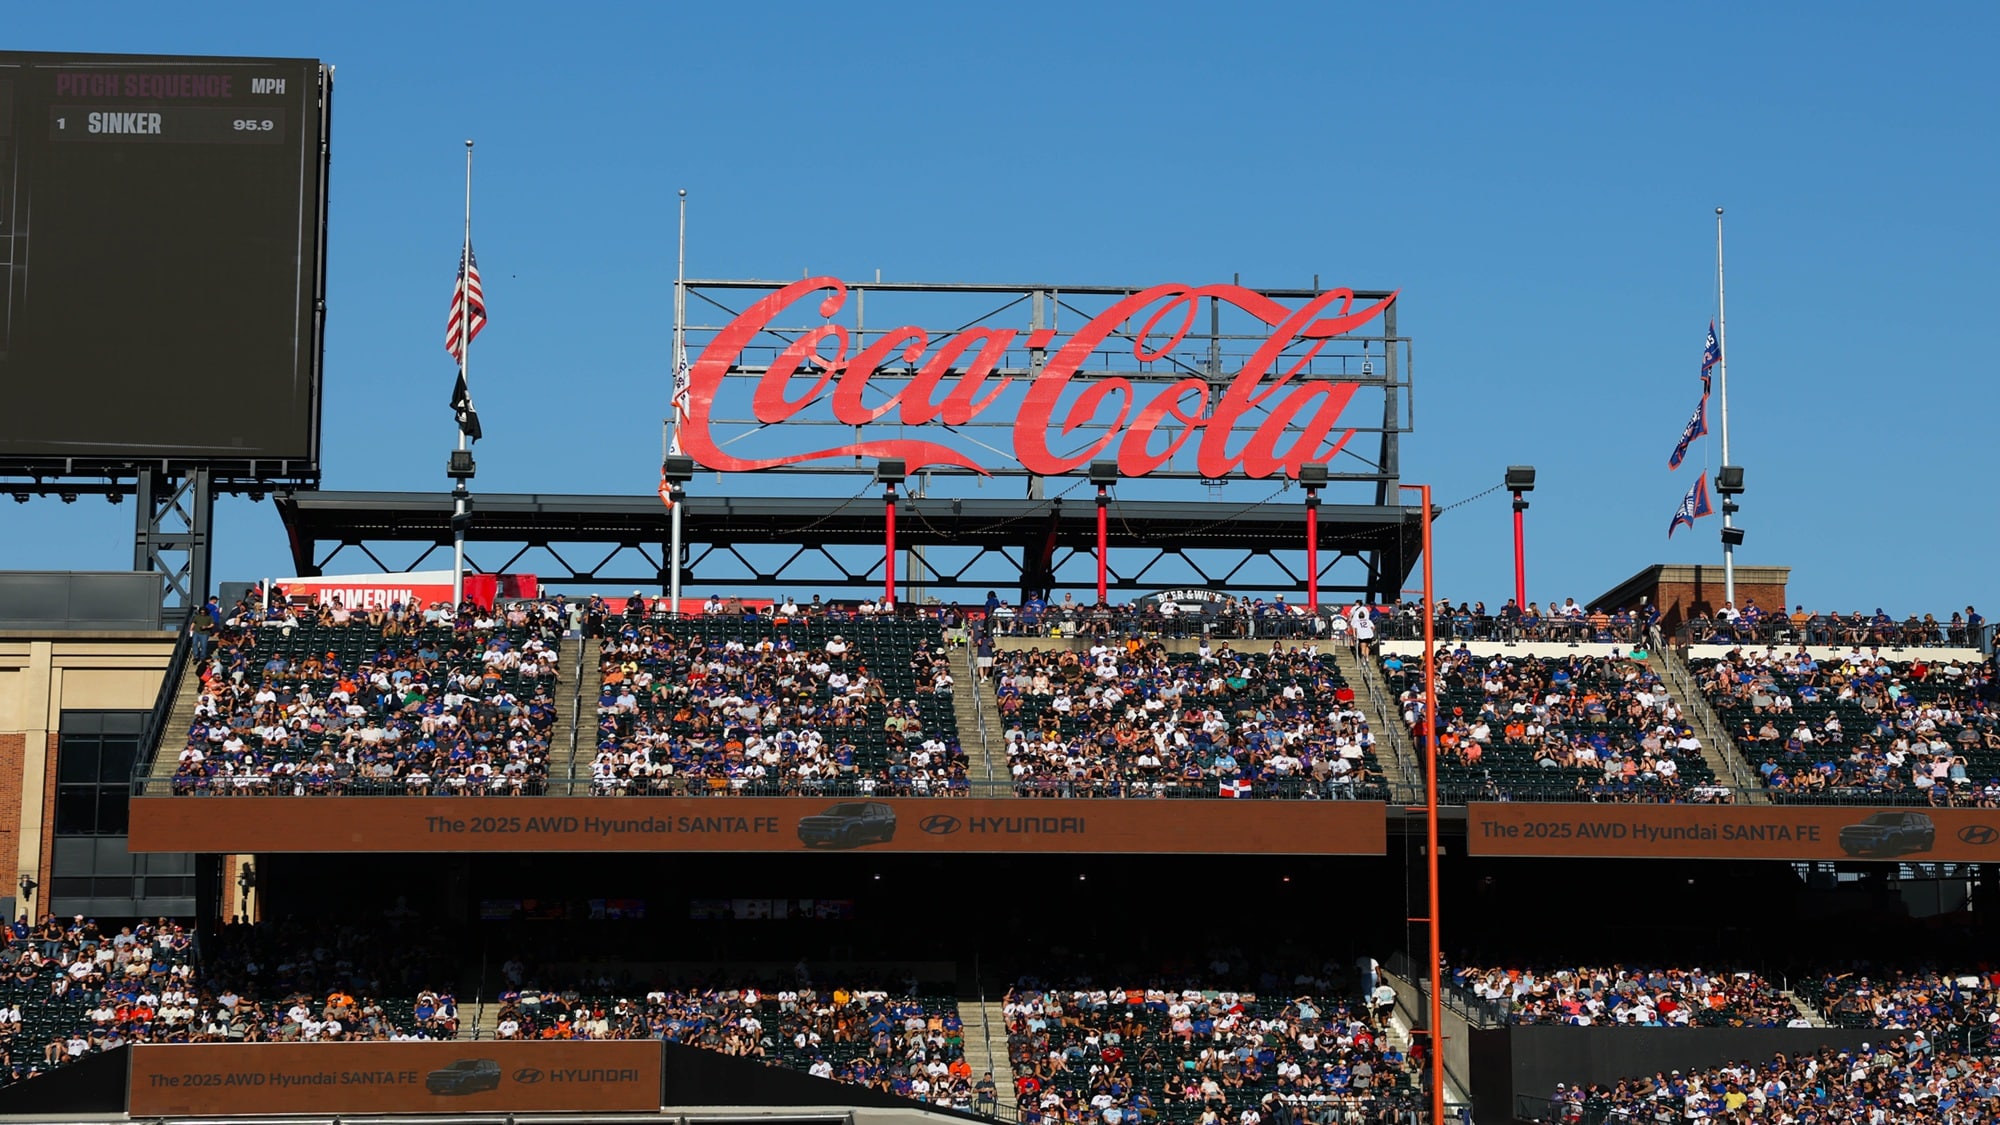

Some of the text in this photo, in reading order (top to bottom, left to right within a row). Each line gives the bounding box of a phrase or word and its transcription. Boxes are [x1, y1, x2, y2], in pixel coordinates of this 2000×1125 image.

[57, 73, 232, 98] PITCH SEQUENCE
[251, 78, 286, 95] MPH
[57, 112, 274, 134] 1 SINKER 95.9
[685, 276, 1402, 479] Coca-Cola
[425, 816, 1084, 837] The 2025 AWD Hyundai SANTA FE HYUNDAI
[1481, 821, 1820, 843] The 2025 AWD Hyundai SANTA FE
[149, 1069, 639, 1089] The 2025 AWD Hyundai SANTA FE HYUNDAI
